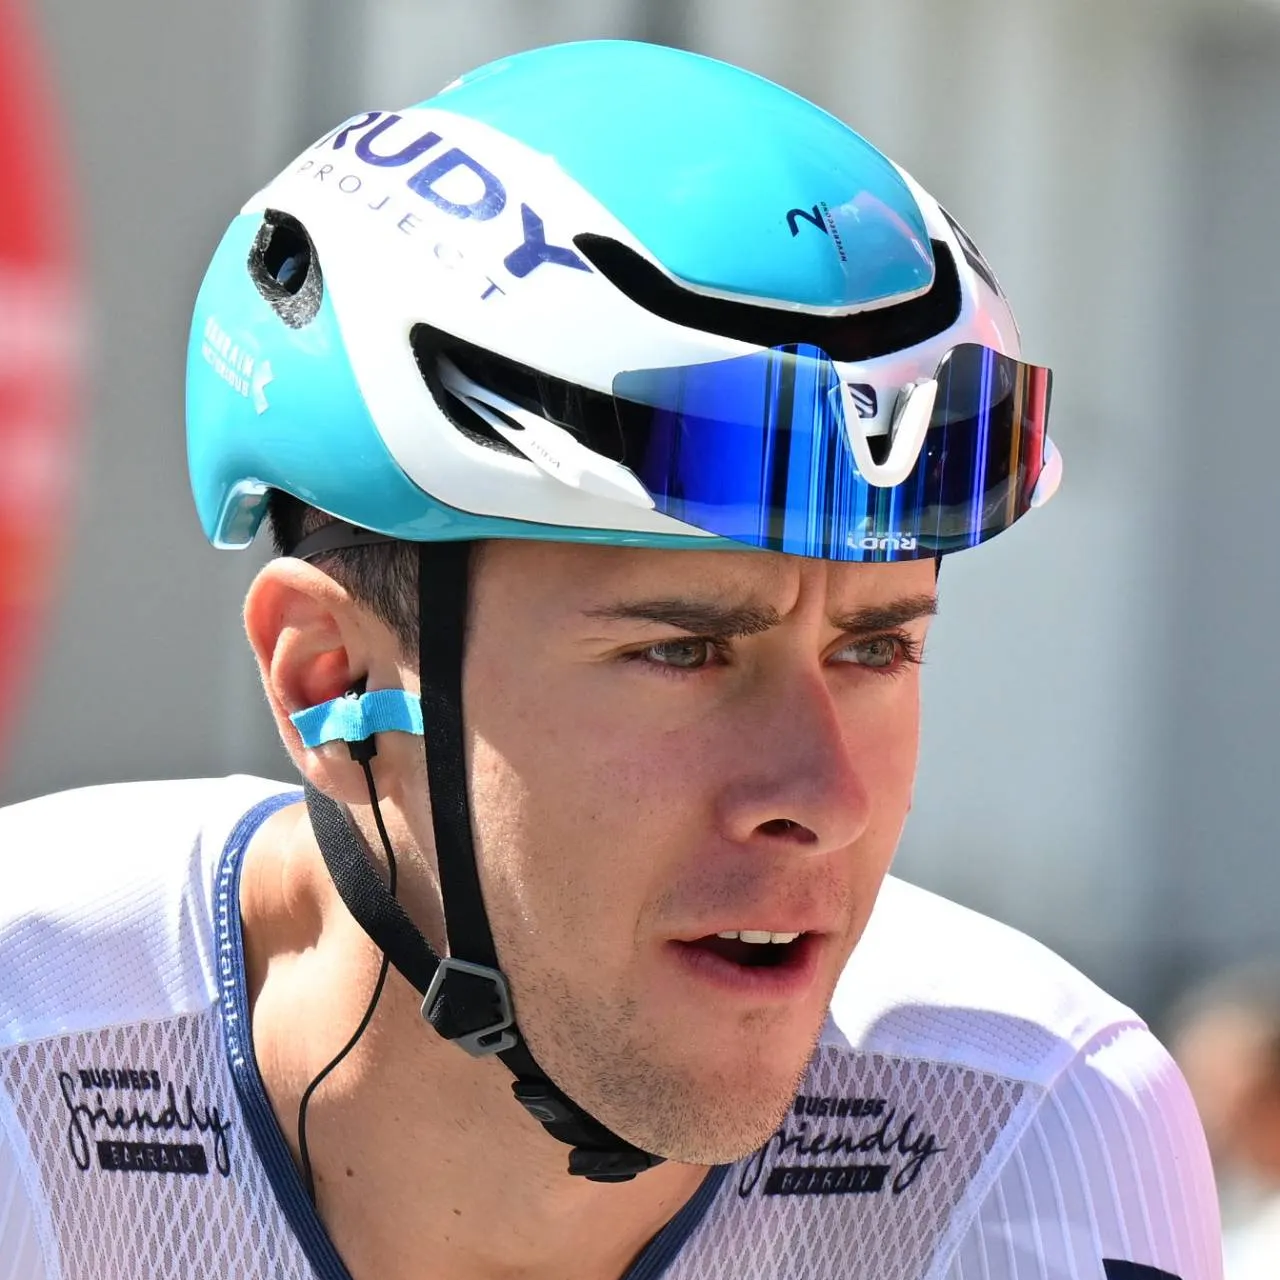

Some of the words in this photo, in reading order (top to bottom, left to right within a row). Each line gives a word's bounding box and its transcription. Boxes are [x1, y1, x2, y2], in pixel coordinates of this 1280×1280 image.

[297, 160, 507, 300] PROJECT
[317, 111, 595, 278] RUDY
[78, 1069, 161, 1091] BUSINESS
[794, 1095, 888, 1118] BUSINESS
